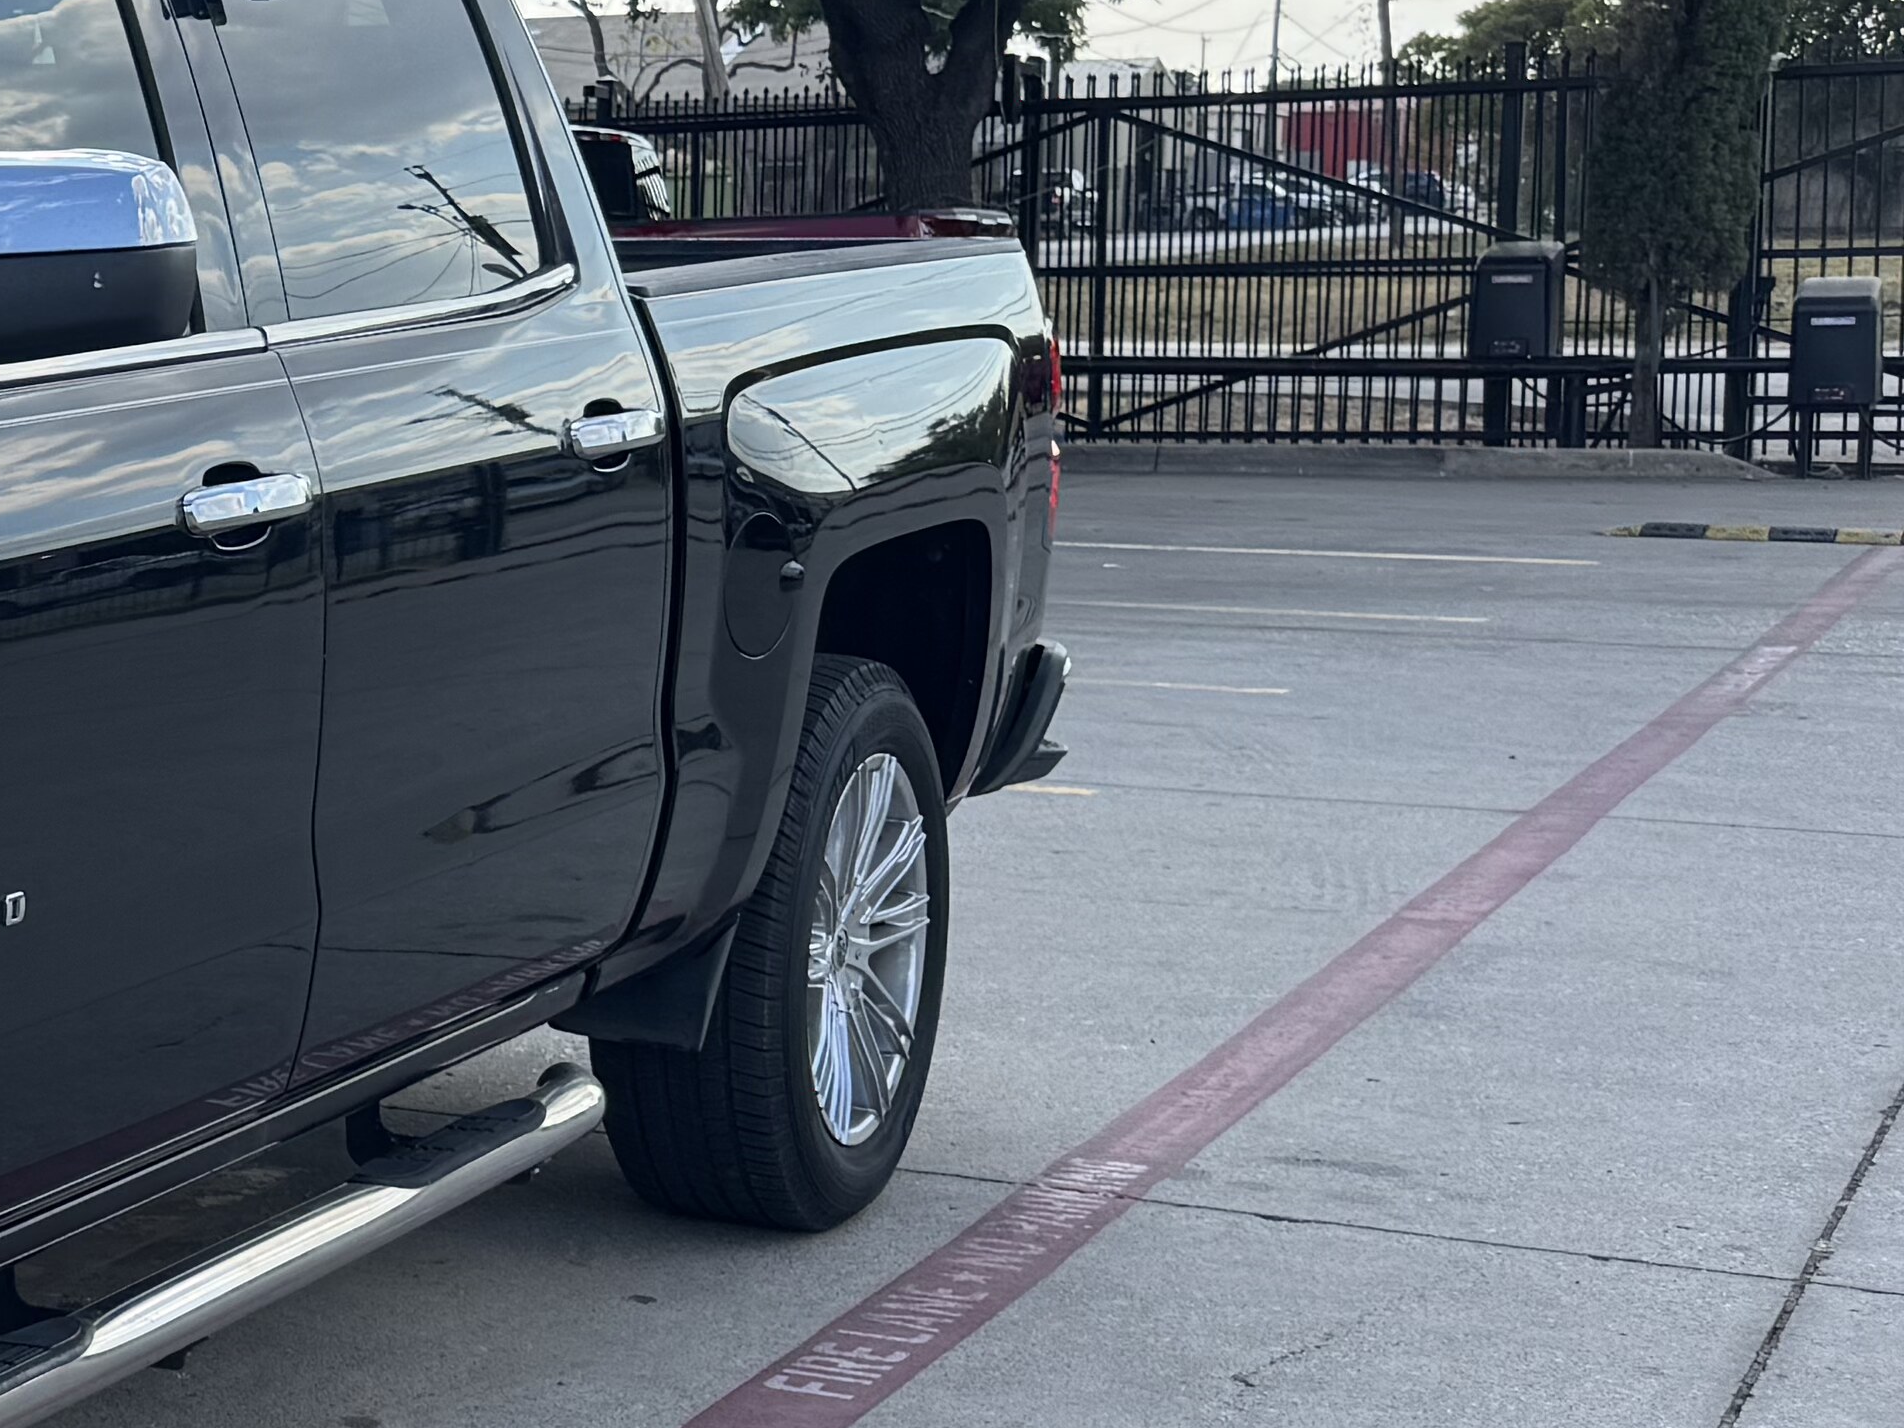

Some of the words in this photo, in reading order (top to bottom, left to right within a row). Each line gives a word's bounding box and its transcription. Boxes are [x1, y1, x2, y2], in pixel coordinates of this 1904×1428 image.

[763, 1342, 910, 1400] FIRE
[837, 1283, 990, 1344] LANE
[946, 1237, 1046, 1272] NO
